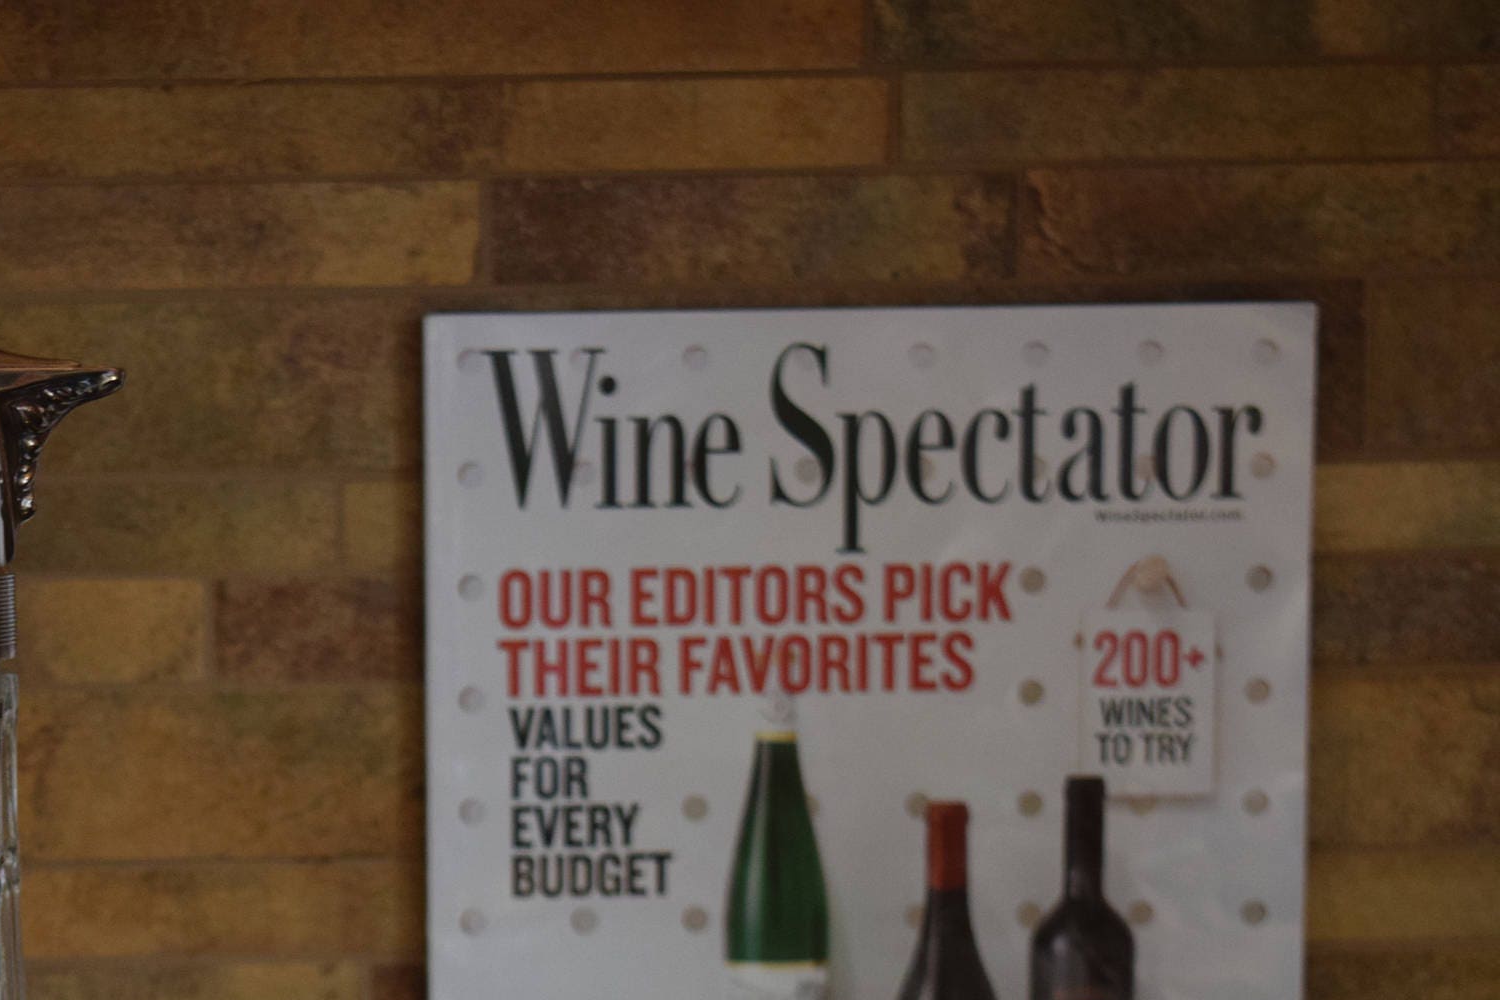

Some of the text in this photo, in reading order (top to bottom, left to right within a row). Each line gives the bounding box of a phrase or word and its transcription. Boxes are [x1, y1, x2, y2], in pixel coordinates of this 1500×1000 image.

[485, 343, 1264, 554] Wine Spectator
[500, 562, 1012, 630] OUR EDITORS PICK
[499, 632, 976, 697] THEIR FAVORITES
[1093, 628, 1205, 689] 200+
[509, 704, 663, 750] VALUES
[1101, 697, 1193, 729] WINES
[1095, 731, 1193, 765] TO TRY
[511, 755, 589, 801] FOR
[512, 804, 639, 850] EVERY
[512, 851, 672, 898] BUDGET
